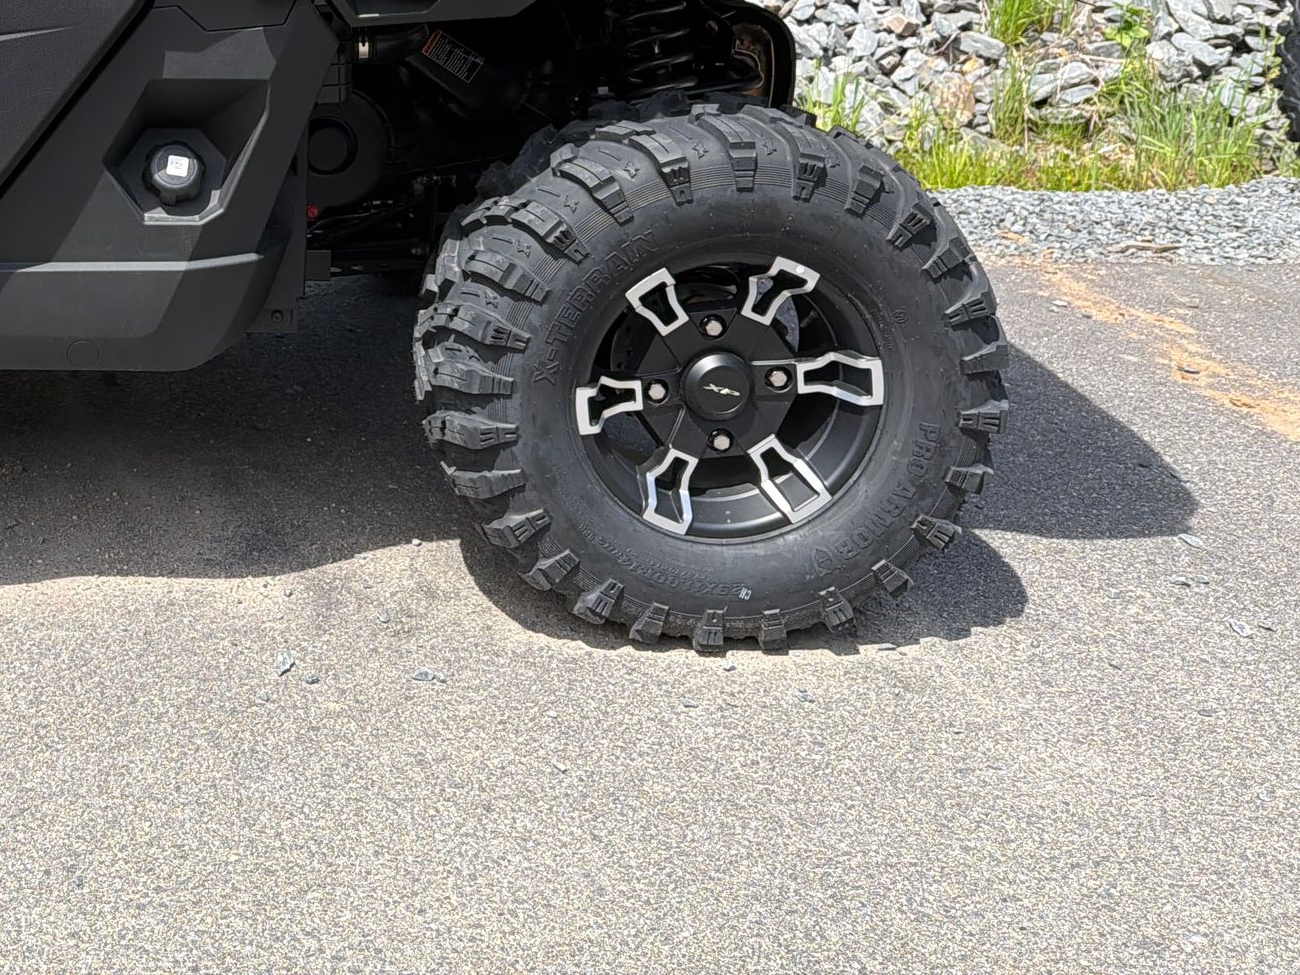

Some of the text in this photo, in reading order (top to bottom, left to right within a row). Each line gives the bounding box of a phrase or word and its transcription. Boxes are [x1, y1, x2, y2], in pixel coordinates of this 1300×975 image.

[532, 228, 660, 386] X-TERRAIN
[702, 383, 741, 397] XP
[834, 421, 941, 561] PRO ARMOR
